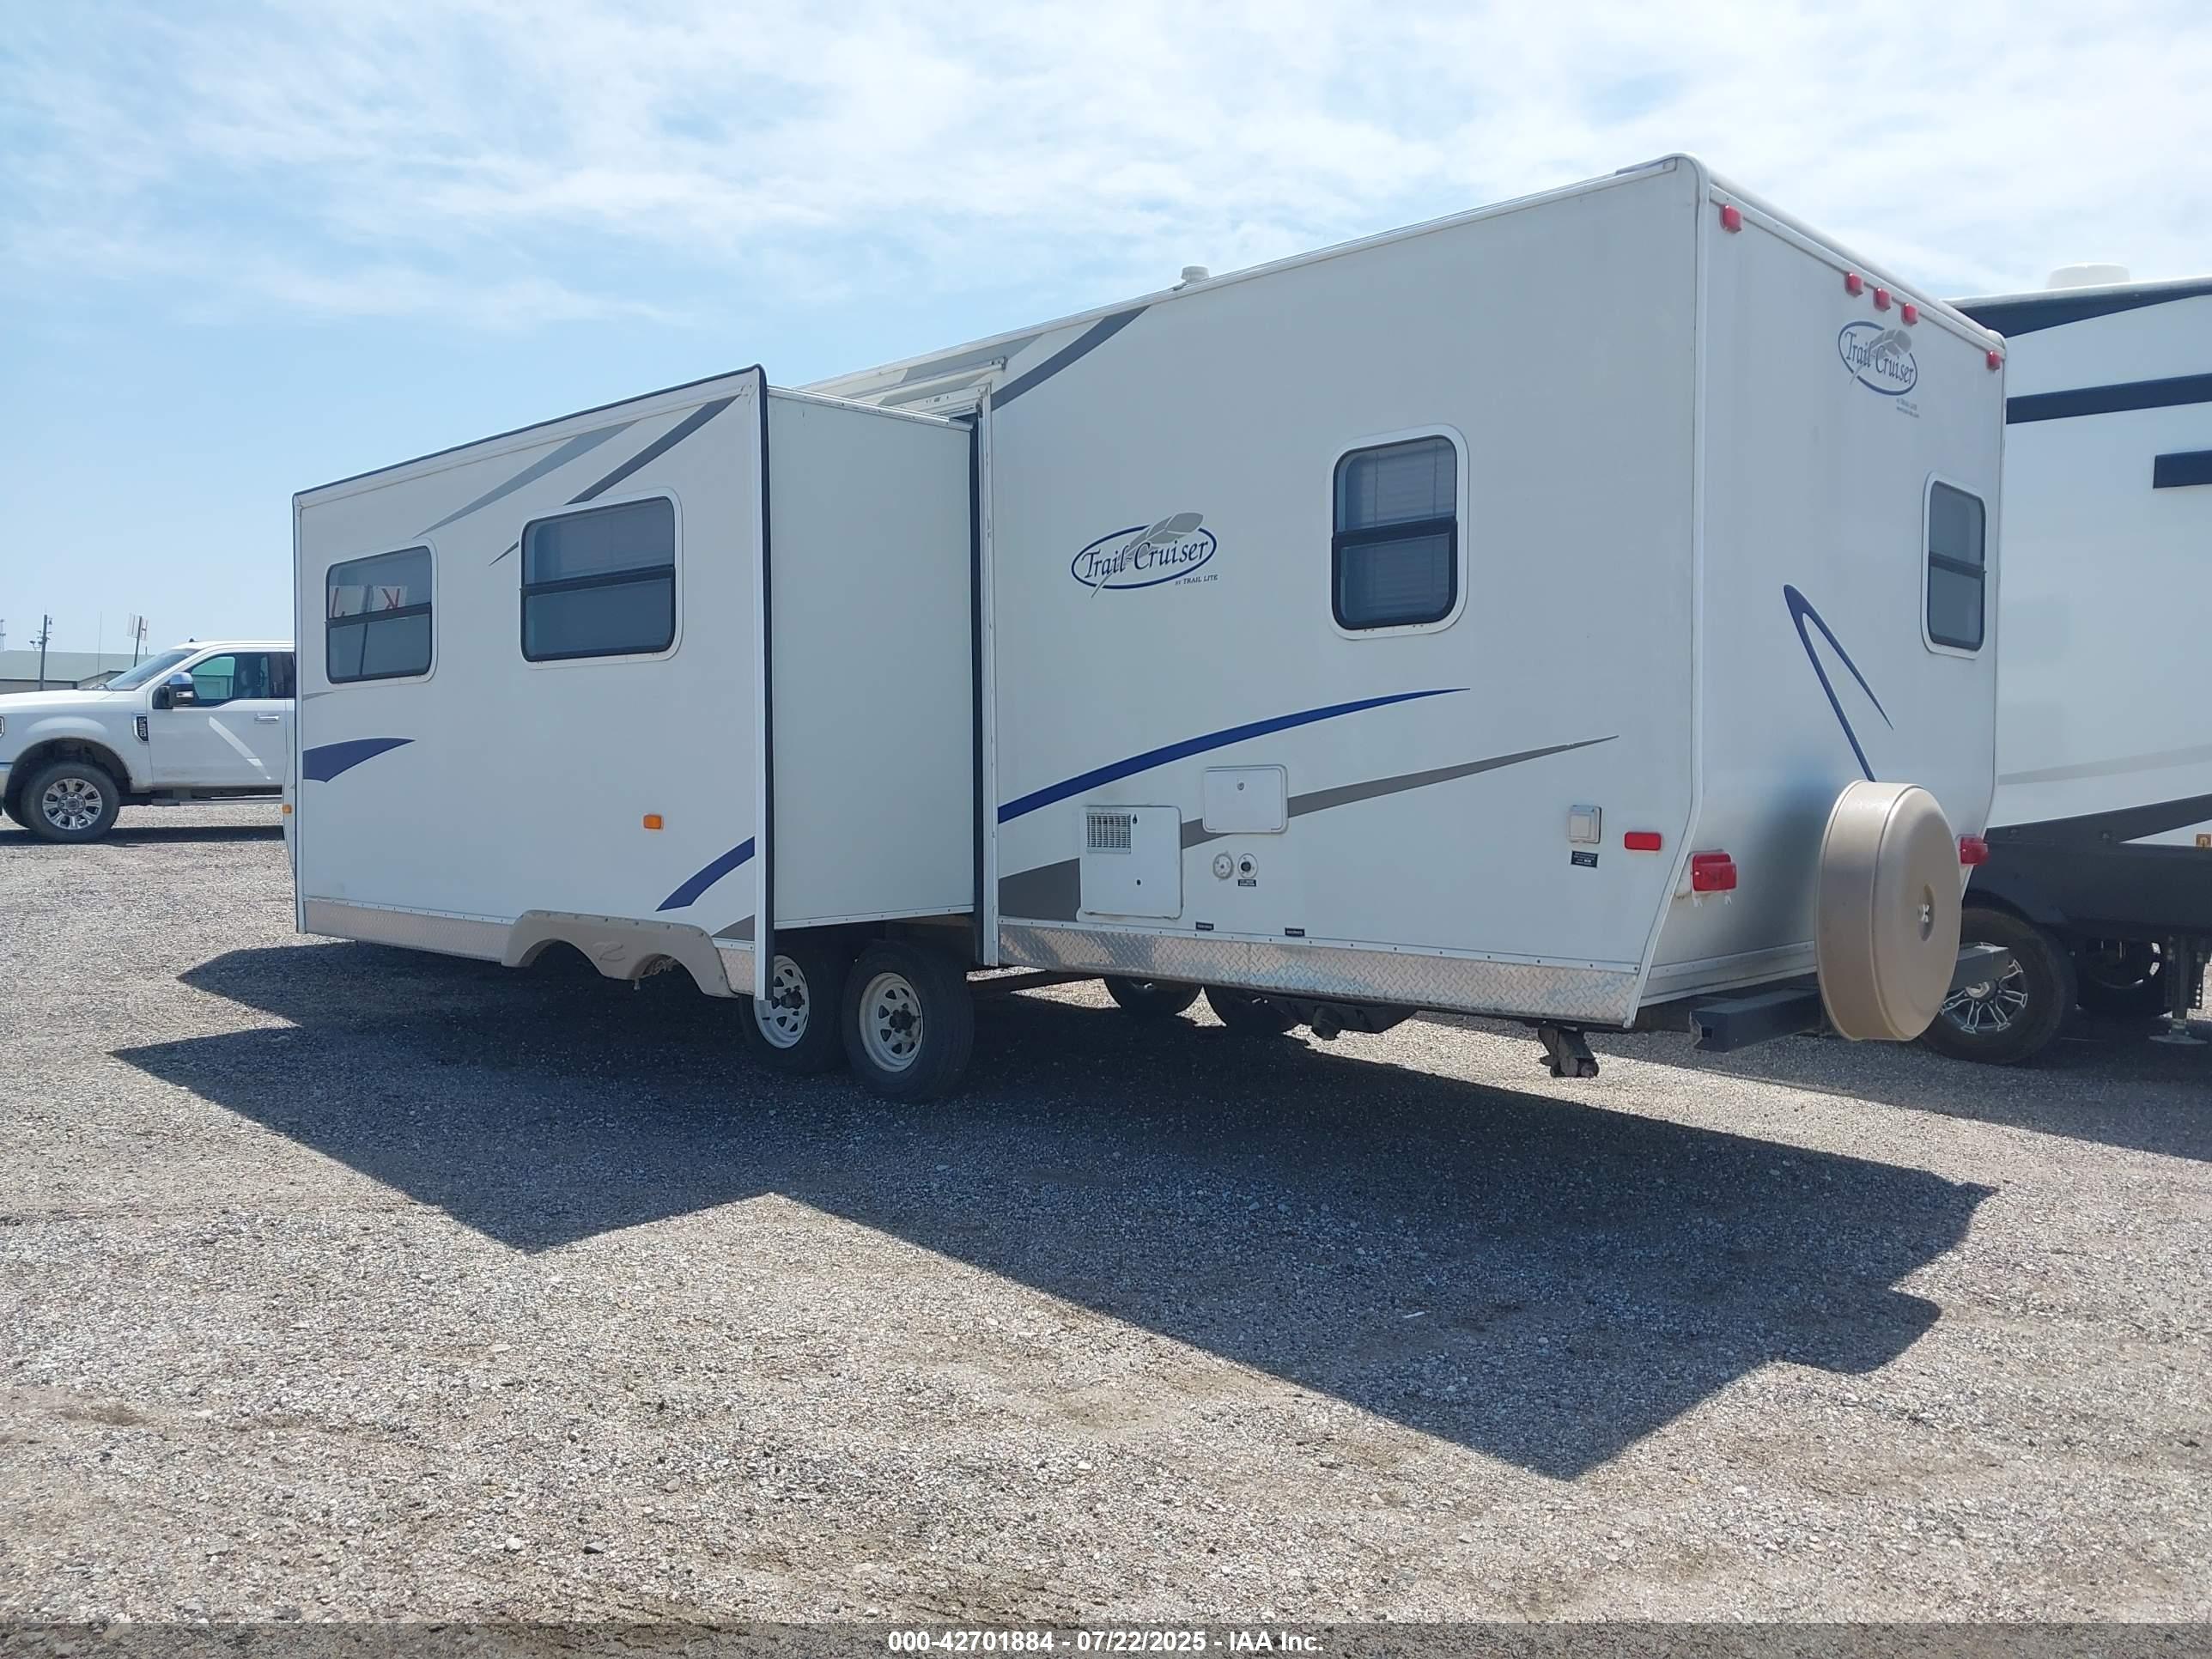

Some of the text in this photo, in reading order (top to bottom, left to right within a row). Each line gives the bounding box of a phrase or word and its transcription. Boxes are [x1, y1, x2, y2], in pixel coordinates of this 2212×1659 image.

[1844, 331, 1914, 384] Trail Cruiser
[1081, 539, 1209, 578] Trail Cruiser
[1183, 576, 1202, 585] TRAIL
